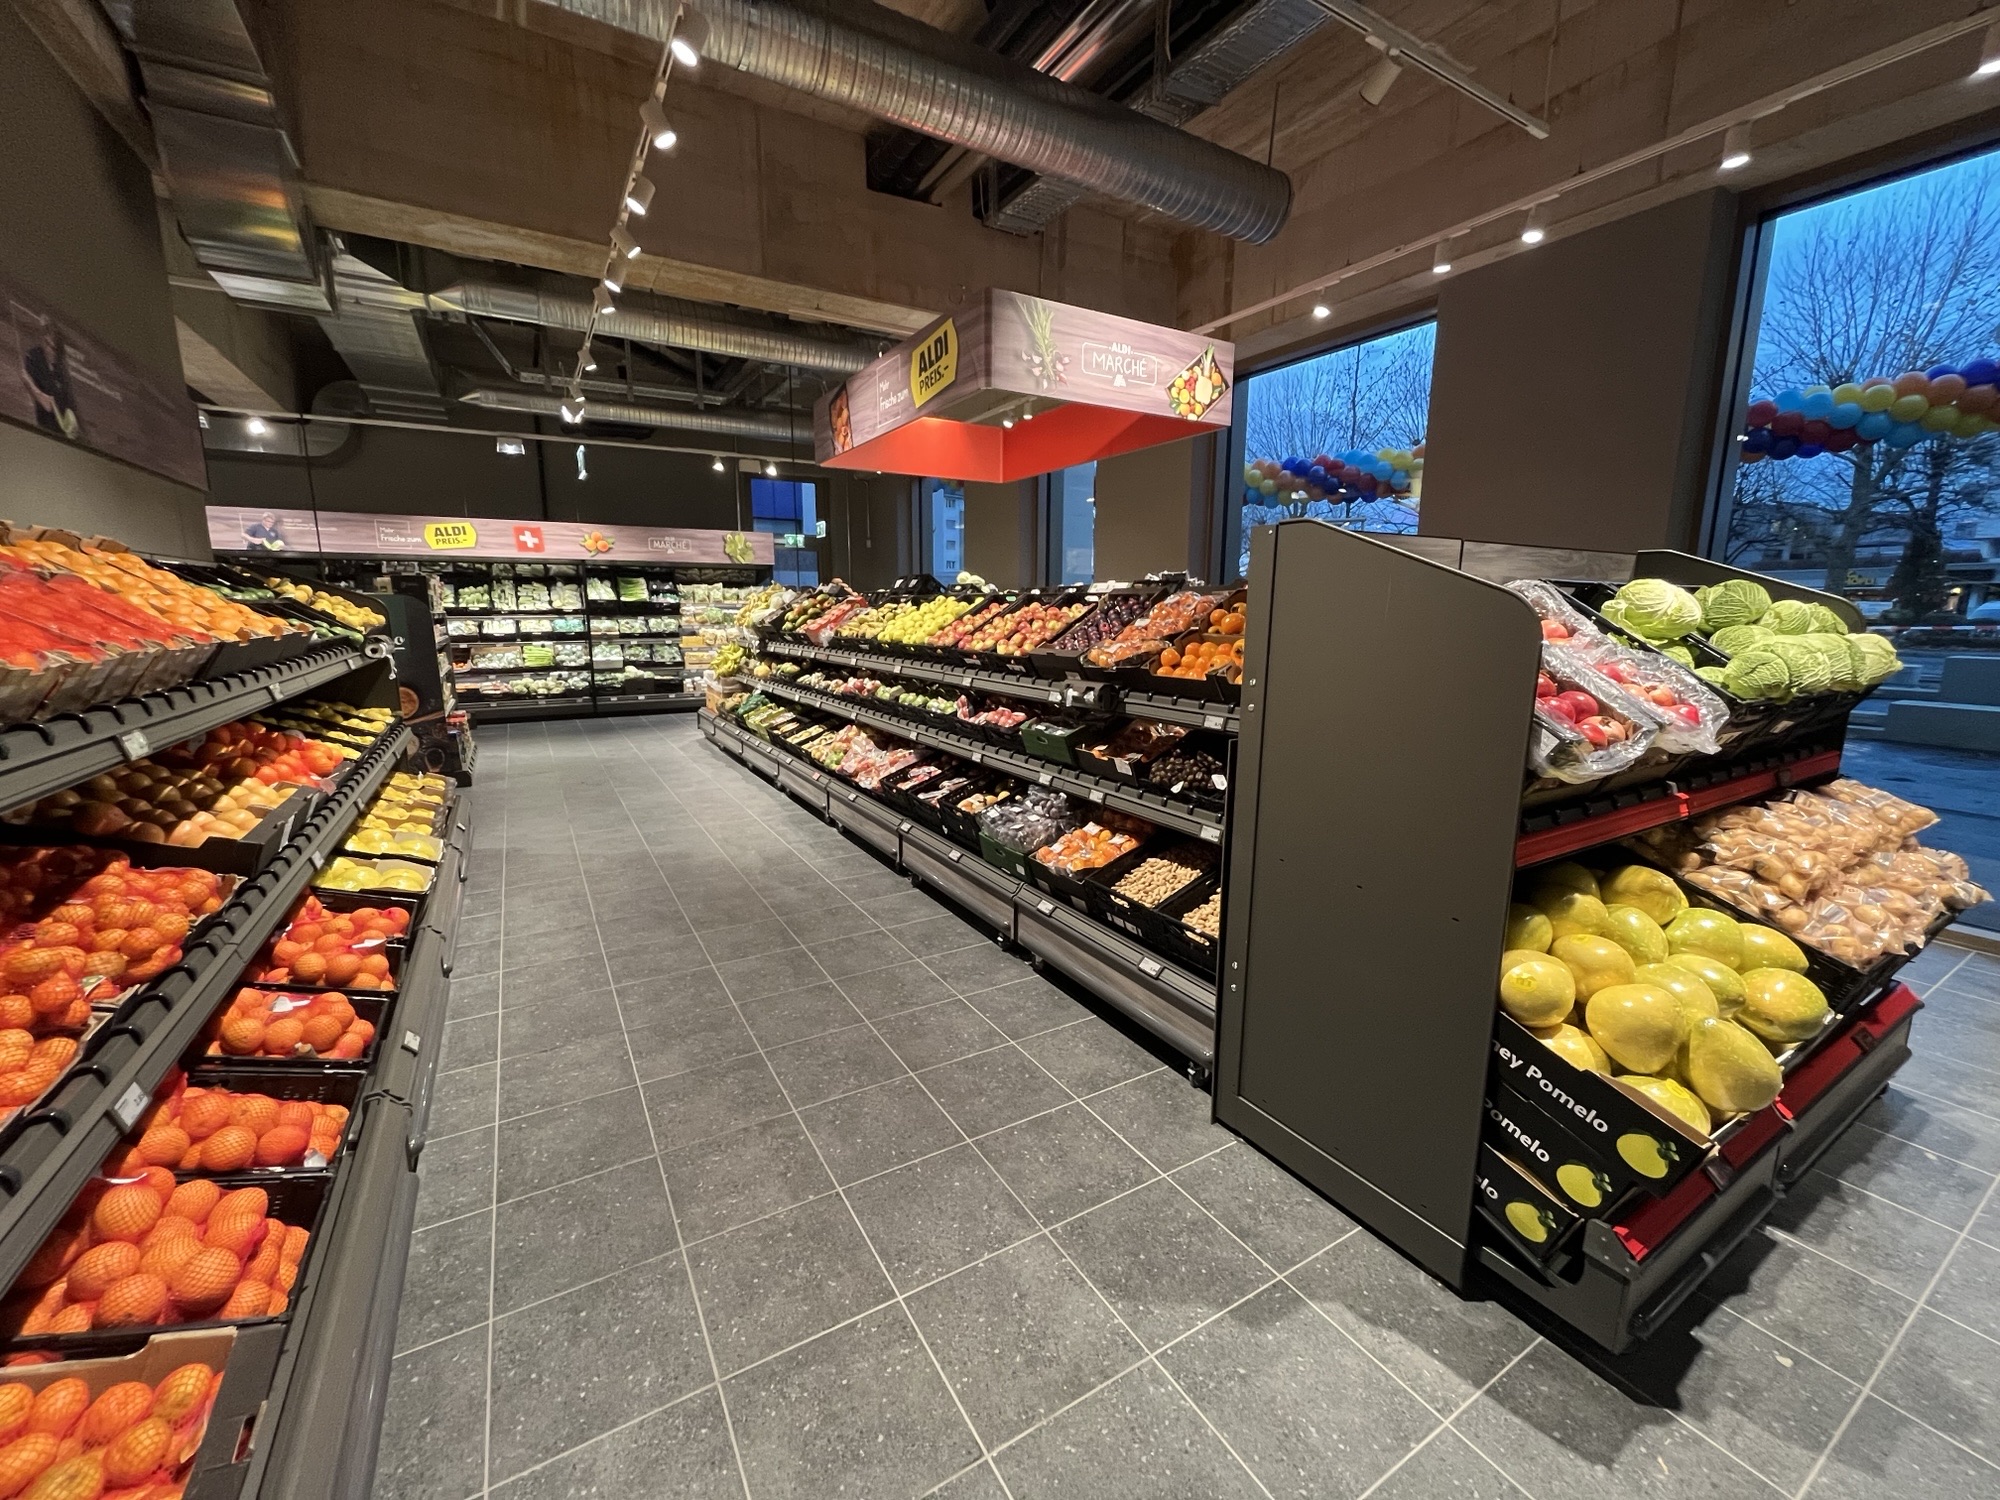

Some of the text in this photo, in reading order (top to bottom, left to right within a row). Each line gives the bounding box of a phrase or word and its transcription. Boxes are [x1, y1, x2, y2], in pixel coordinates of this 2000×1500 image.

[918, 330, 949, 378] ALDI
[1110, 341, 1132, 355] ALDI
[1092, 351, 1148, 378] MARCHÉ
[897, 388, 909, 402] zum
[434, 525, 467, 537] ALDI
[380, 534, 405, 543] Frische
[653, 539, 687, 550] MARCHÉ
[1525, 1064, 1608, 1133] Pomelo
